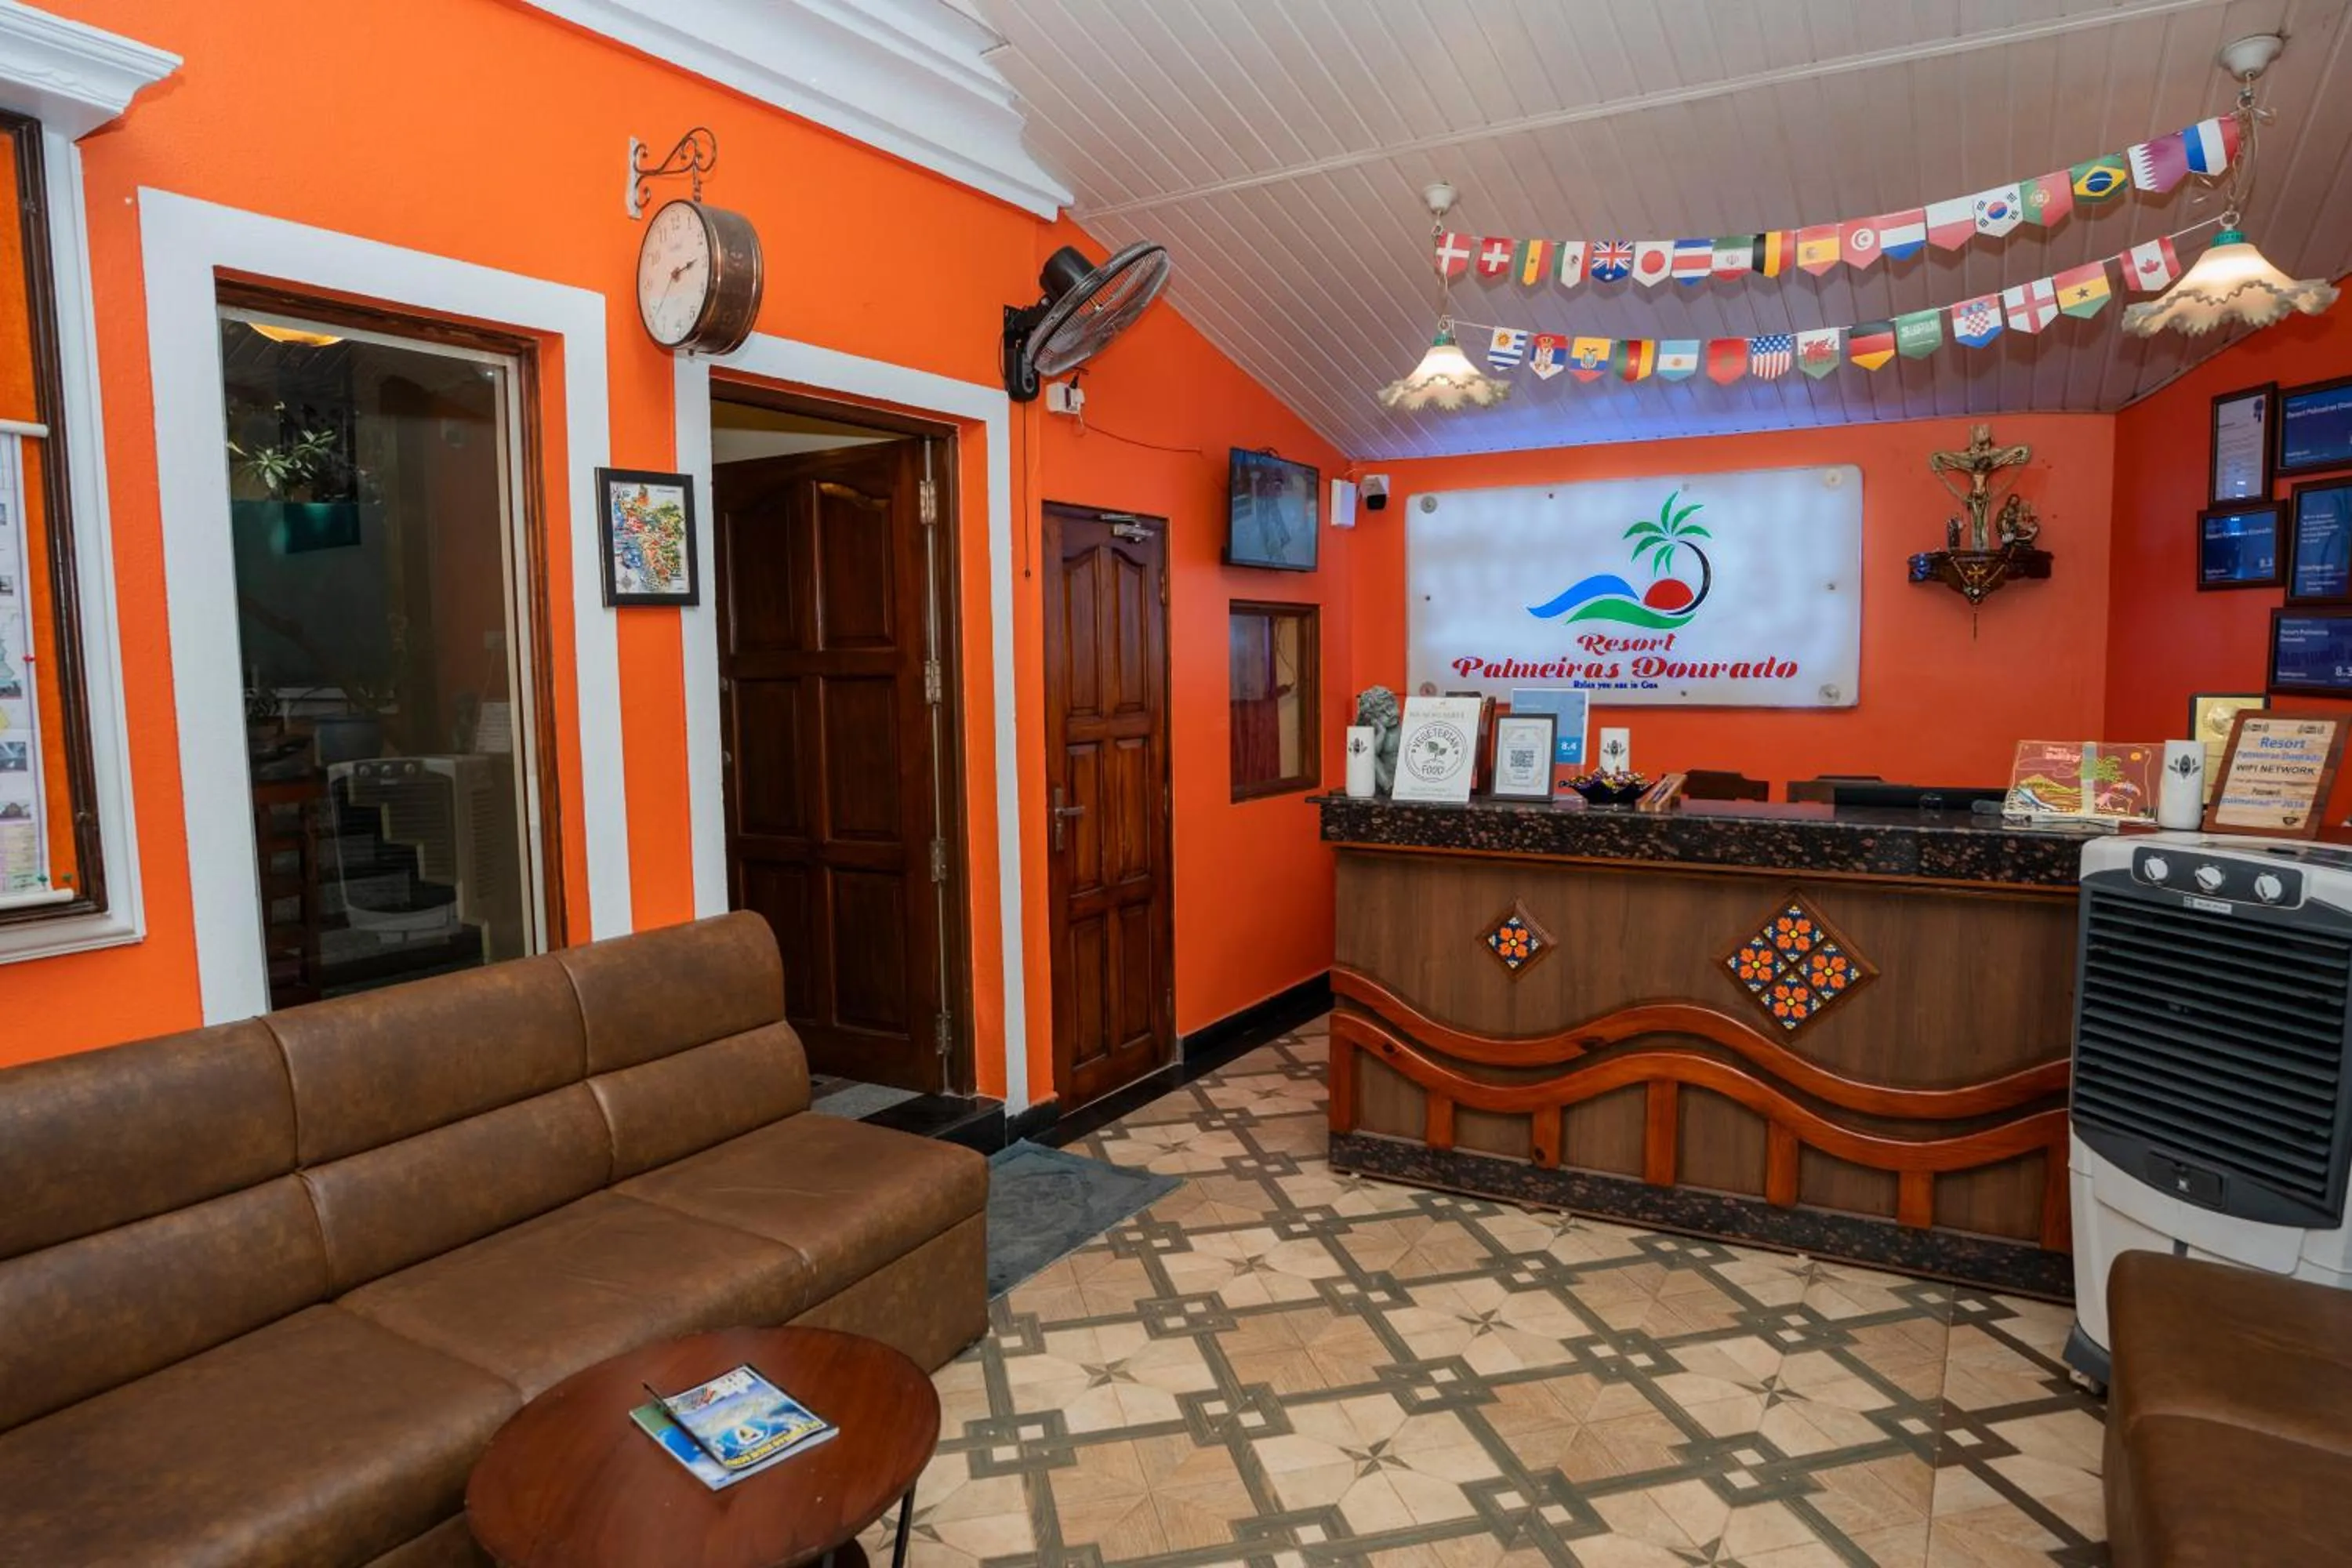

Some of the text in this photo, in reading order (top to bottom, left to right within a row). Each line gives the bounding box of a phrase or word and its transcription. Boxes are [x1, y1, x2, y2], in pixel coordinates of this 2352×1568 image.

[1577, 633, 1676, 656] Resort
[1451, 655, 1798, 679] Palmeiras Dourado
[1560, 741, 1577, 750] 8.4
[2259, 735, 2307, 749] Resort
[1421, 764, 1444, 775] FOOD
[2236, 764, 2316, 776] WIFI NETWORK
